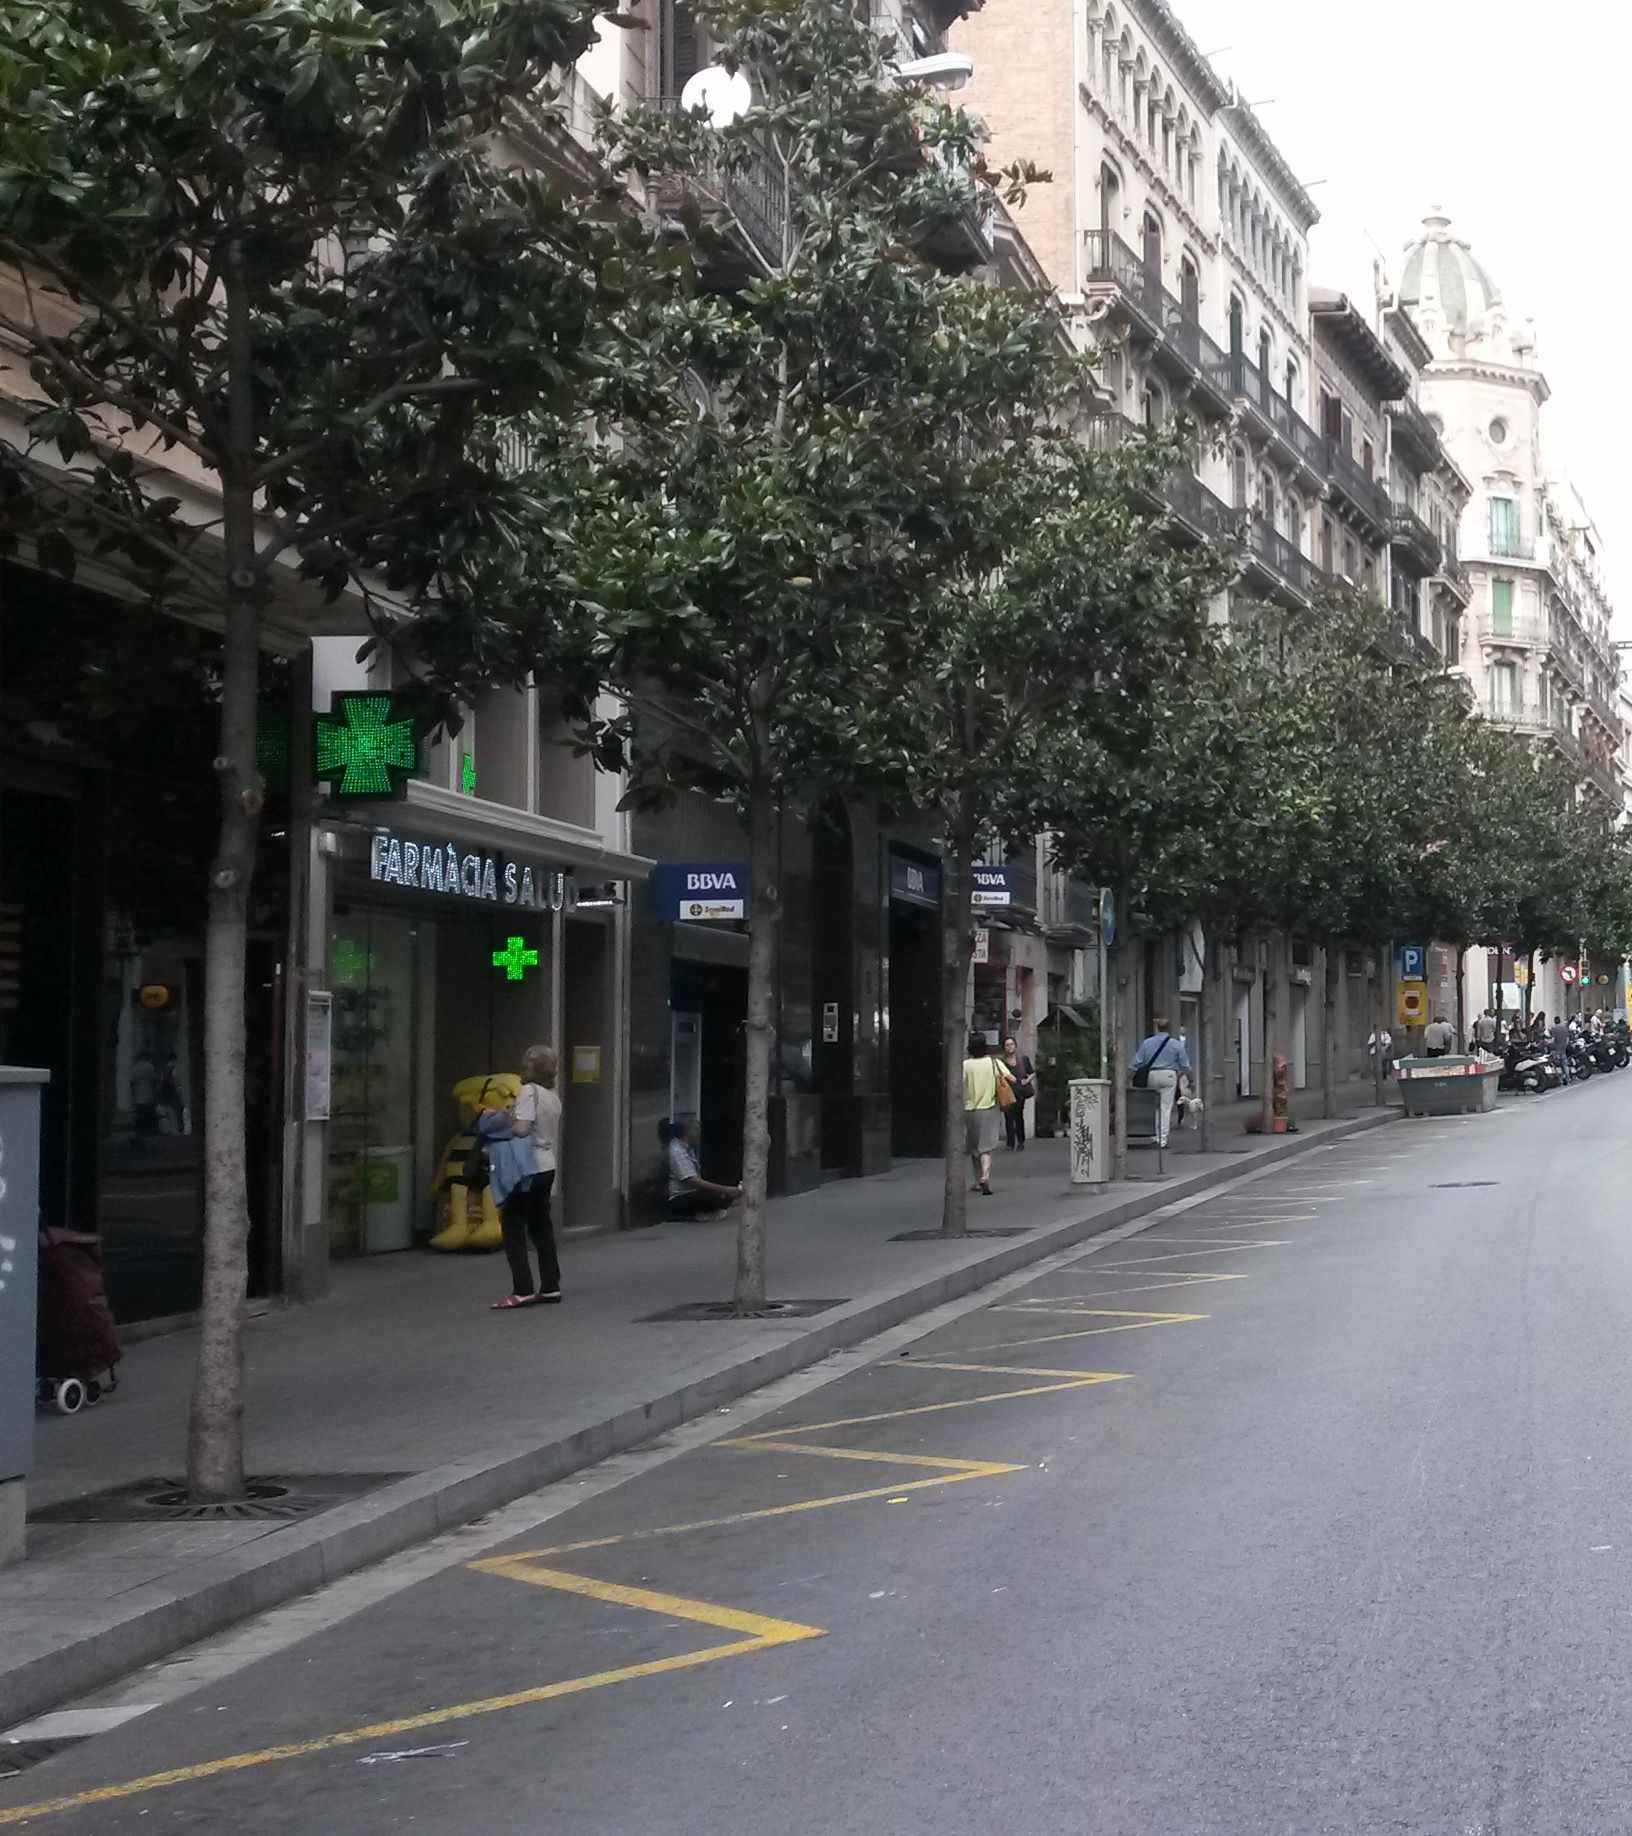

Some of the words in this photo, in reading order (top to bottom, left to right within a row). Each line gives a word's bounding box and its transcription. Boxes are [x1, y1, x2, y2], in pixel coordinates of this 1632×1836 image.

[371, 834, 498, 901] FARMÀCIA
[687, 872, 737, 890] BBVA
[1404, 950, 1418, 972] P
